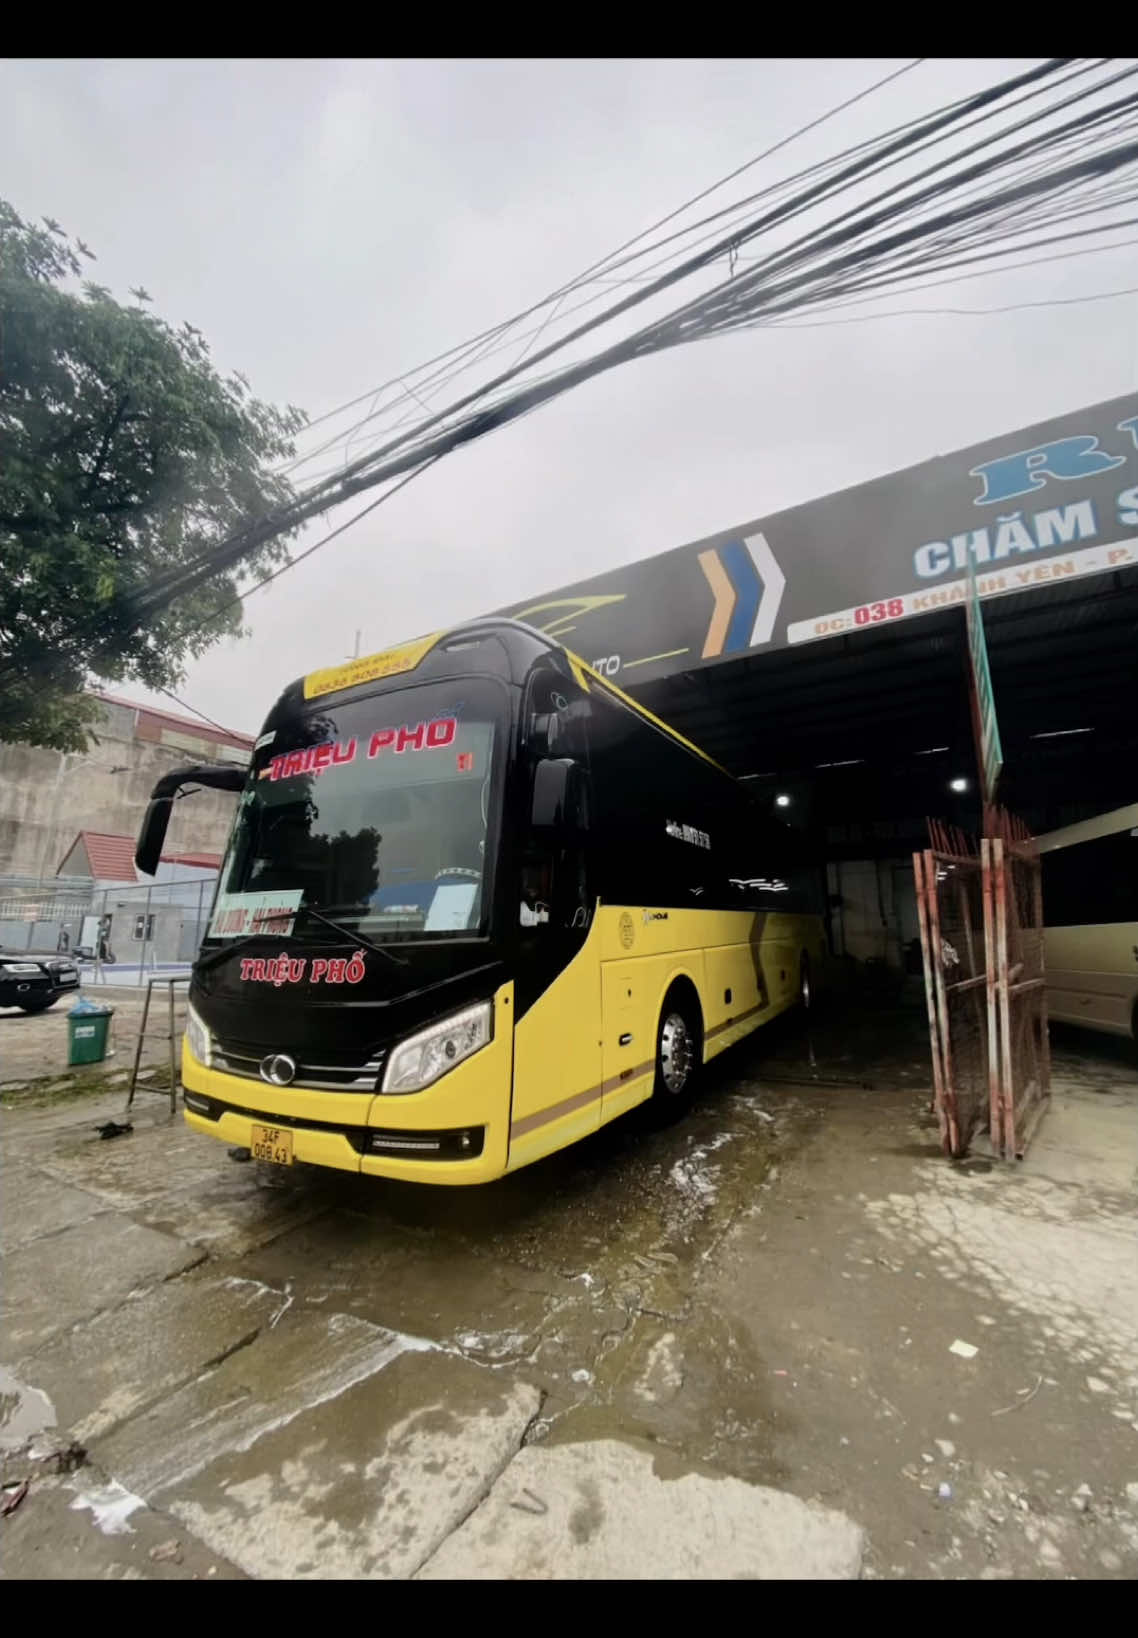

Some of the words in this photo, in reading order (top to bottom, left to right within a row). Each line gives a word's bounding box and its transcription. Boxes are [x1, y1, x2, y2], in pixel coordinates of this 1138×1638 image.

[914, 500, 1097, 579] CHĂM
[855, 598, 904, 625] 038
[240, 952, 307, 987] TRIỆU
[310, 948, 367, 984] PHỐ
